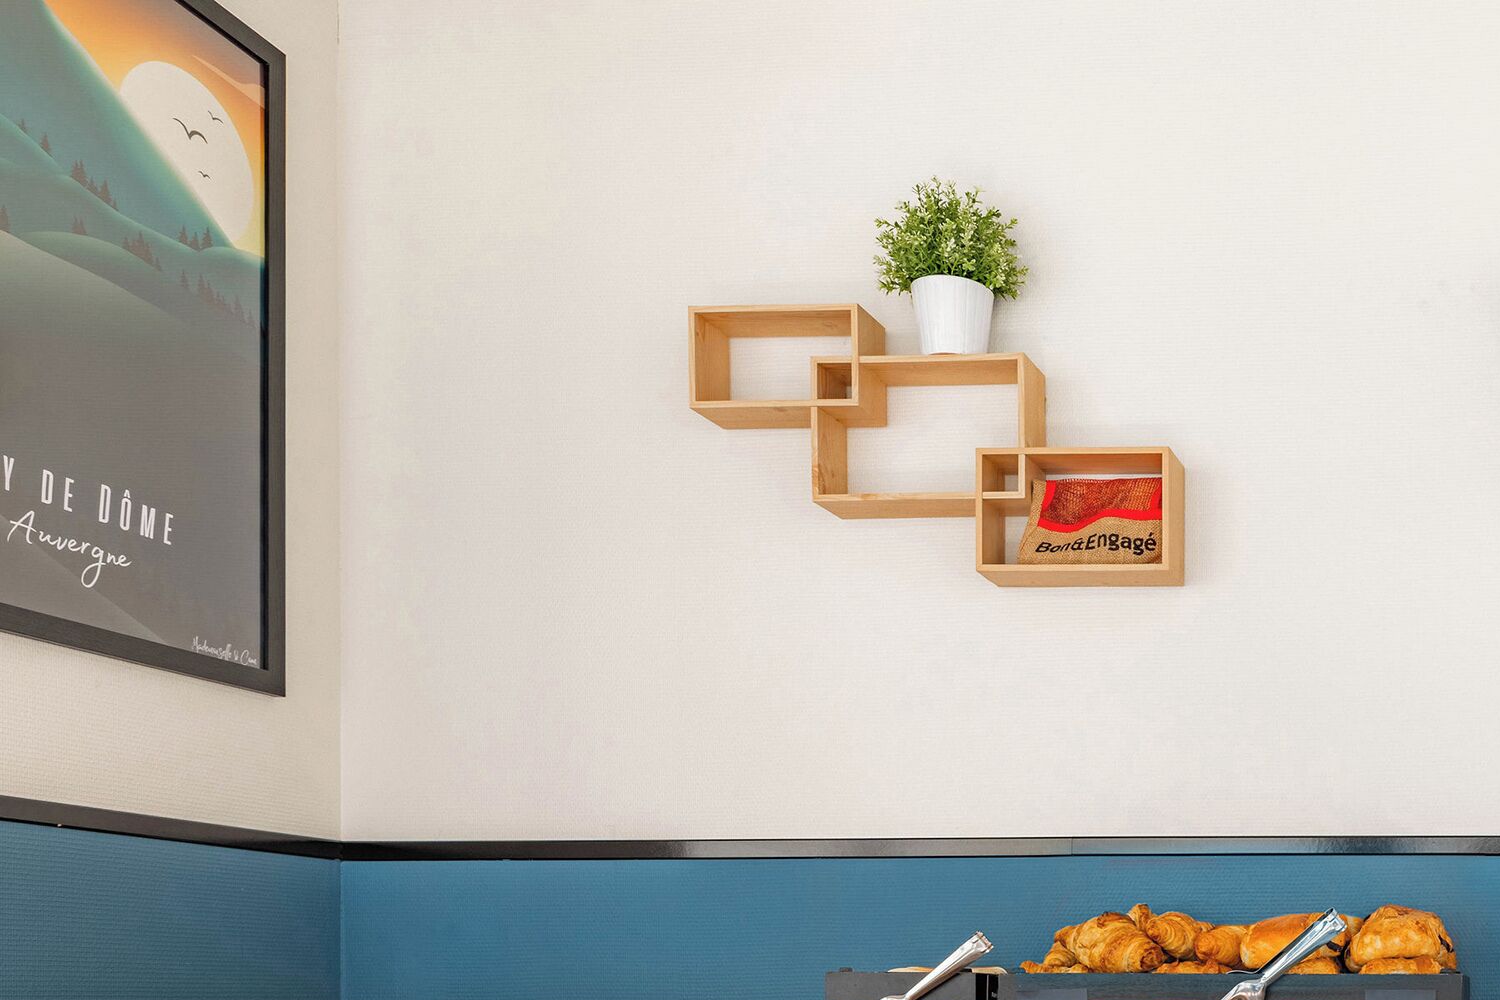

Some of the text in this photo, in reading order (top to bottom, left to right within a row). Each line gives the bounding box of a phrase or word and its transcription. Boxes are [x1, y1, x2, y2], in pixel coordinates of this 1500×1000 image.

[40, 468, 75, 512] DE
[98, 483, 174, 545] DÔME
[6, 510, 132, 588] Auvergne
